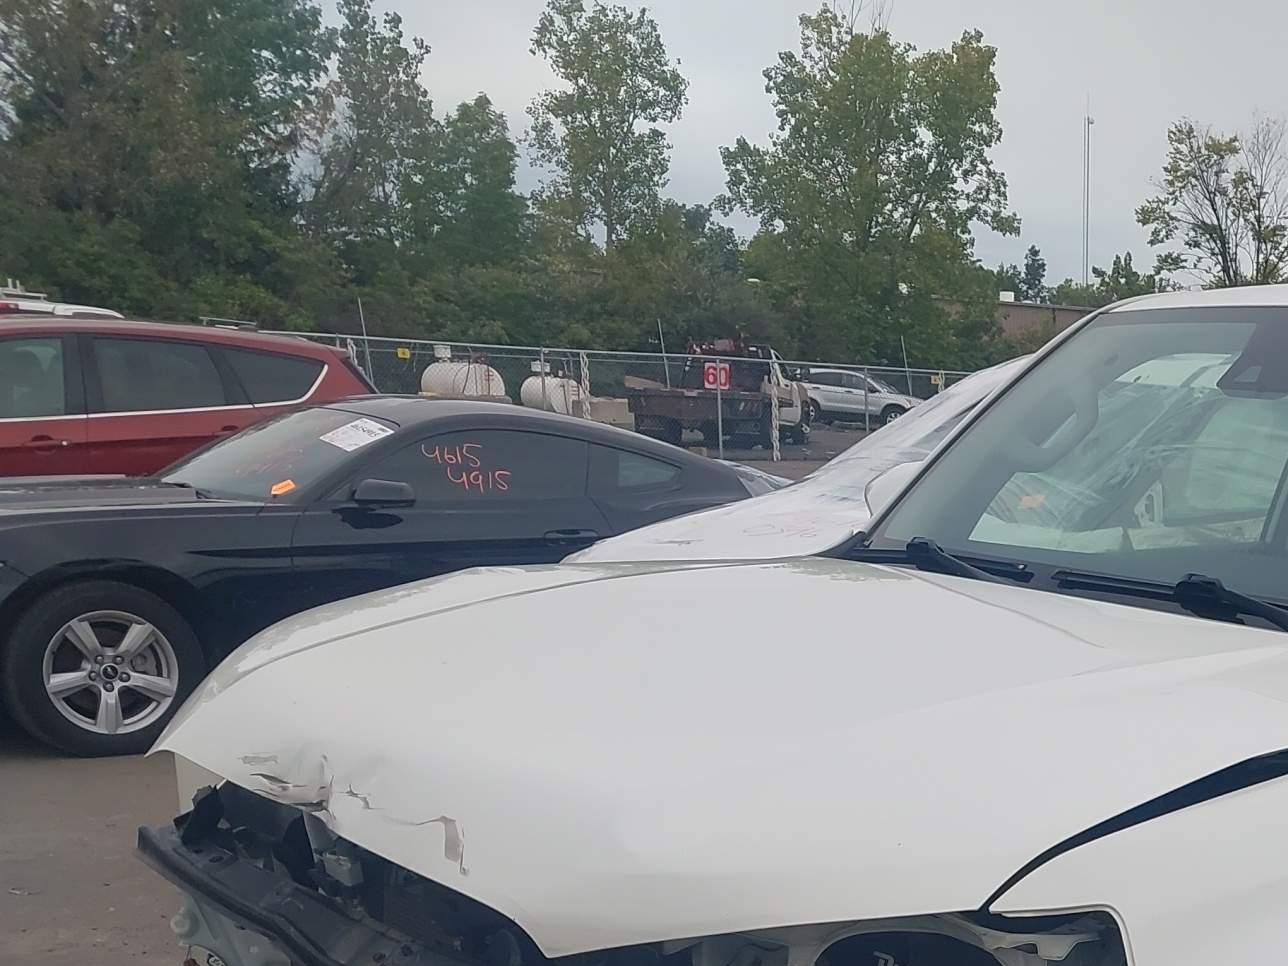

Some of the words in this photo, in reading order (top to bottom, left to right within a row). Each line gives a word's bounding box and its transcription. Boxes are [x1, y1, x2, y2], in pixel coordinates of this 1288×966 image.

[704, 365, 730, 387] 60
[421, 443, 483, 468] 4615
[447, 466, 512, 493] 4915
